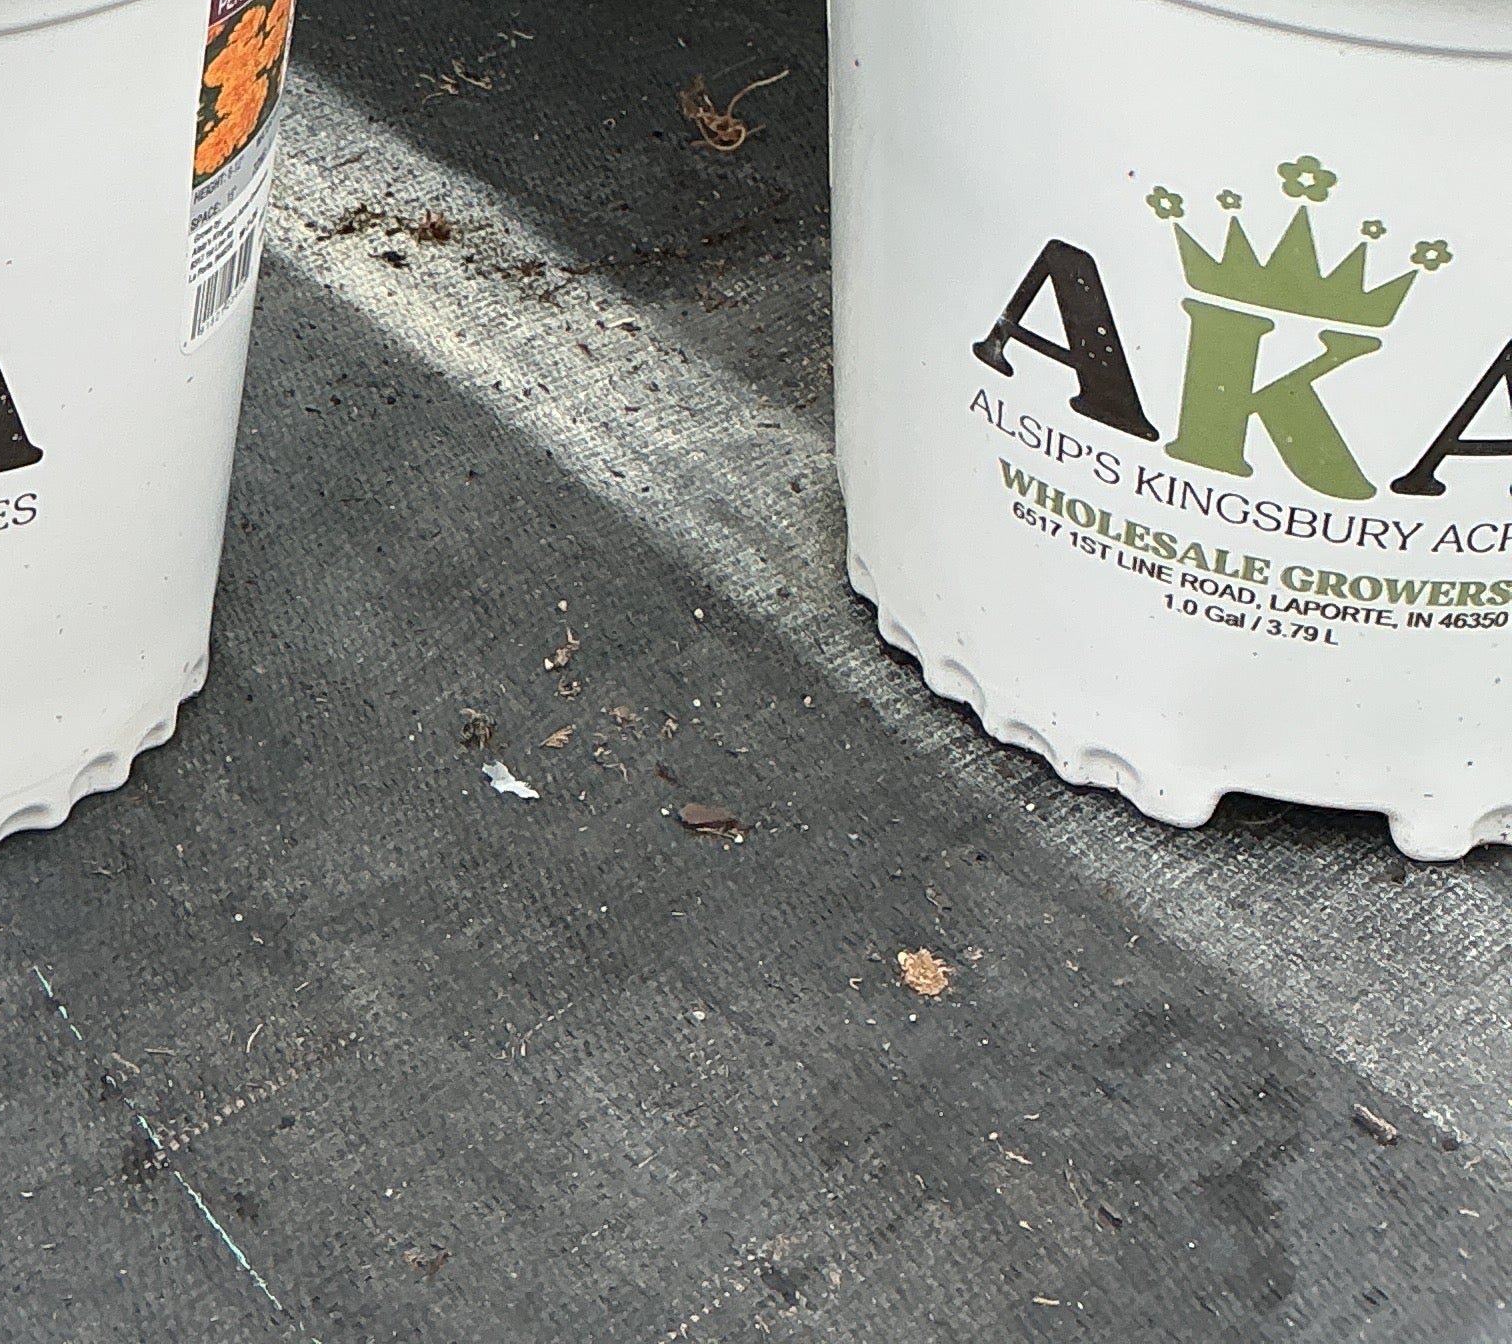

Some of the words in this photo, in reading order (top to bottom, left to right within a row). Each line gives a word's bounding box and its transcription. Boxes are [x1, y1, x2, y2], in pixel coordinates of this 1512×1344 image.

[970, 389, 1120, 484] ALSIP'S
[1135, 466, 1424, 552] KINGSBURY
[999, 457, 1271, 585] WHOLESALE
[1280, 565, 1512, 608] GROWERS
[1012, 501, 1062, 537] 6517
[1069, 531, 1112, 560] 1ST
[1118, 551, 1173, 584] LINE
[1180, 573, 1262, 610] ROAD,
[1270, 595, 1399, 629] LAPORTE,
[1407, 612, 1433, 628] IN
[1438, 611, 1509, 629] 46350
[1164, 594, 1198, 616] 1.0
[1205, 605, 1245, 629] Gal
[1250, 615, 1261, 631] /
[1266, 620, 1319, 643] 3.79
[1324, 629, 1339, 645] L
